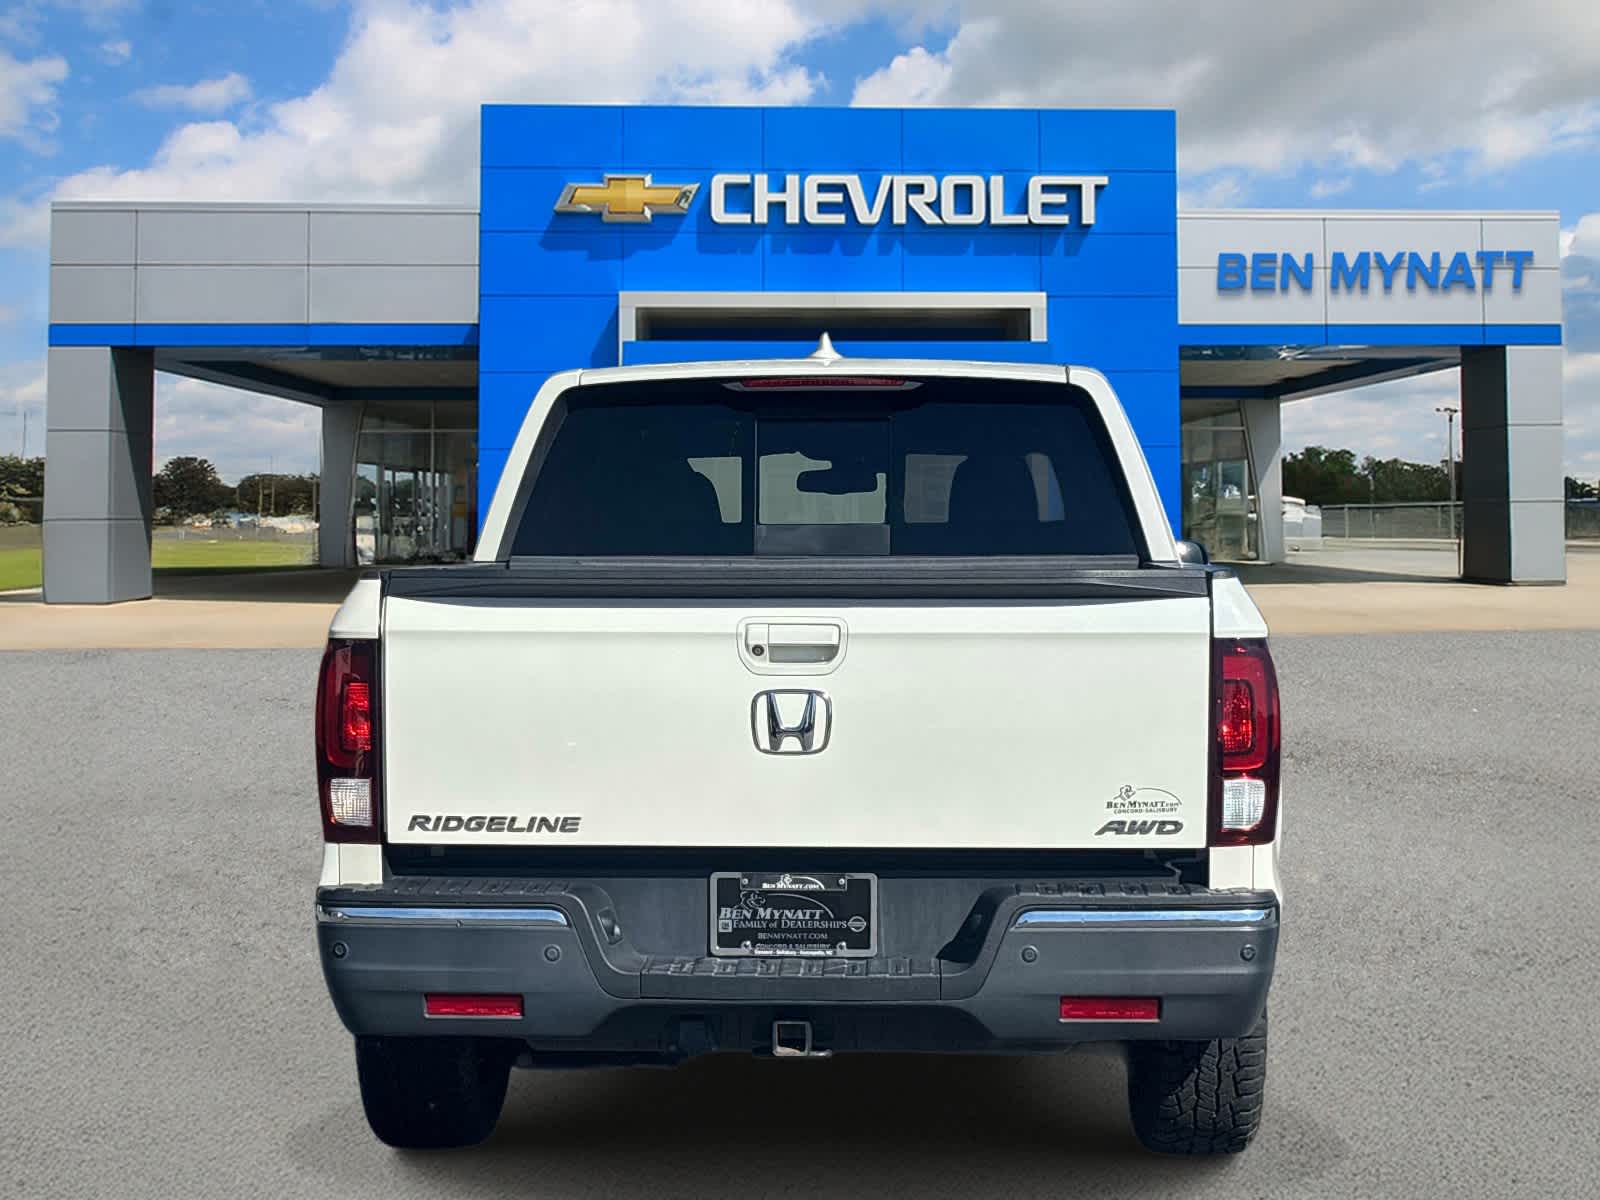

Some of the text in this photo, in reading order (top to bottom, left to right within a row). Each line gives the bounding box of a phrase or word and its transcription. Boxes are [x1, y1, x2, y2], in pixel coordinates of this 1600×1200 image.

[710, 173, 1109, 225] CHEVROLET
[1217, 251, 1534, 290] BEN MYNATT
[407, 814, 582, 833] RIDGELINE
[1094, 820, 1184, 835] AWD
[719, 907, 824, 919] BEN MYNATT
[733, 919, 768, 929] FAMILY
[769, 919, 777, 929] of
[780, 919, 847, 929] DEALERSHIPS
